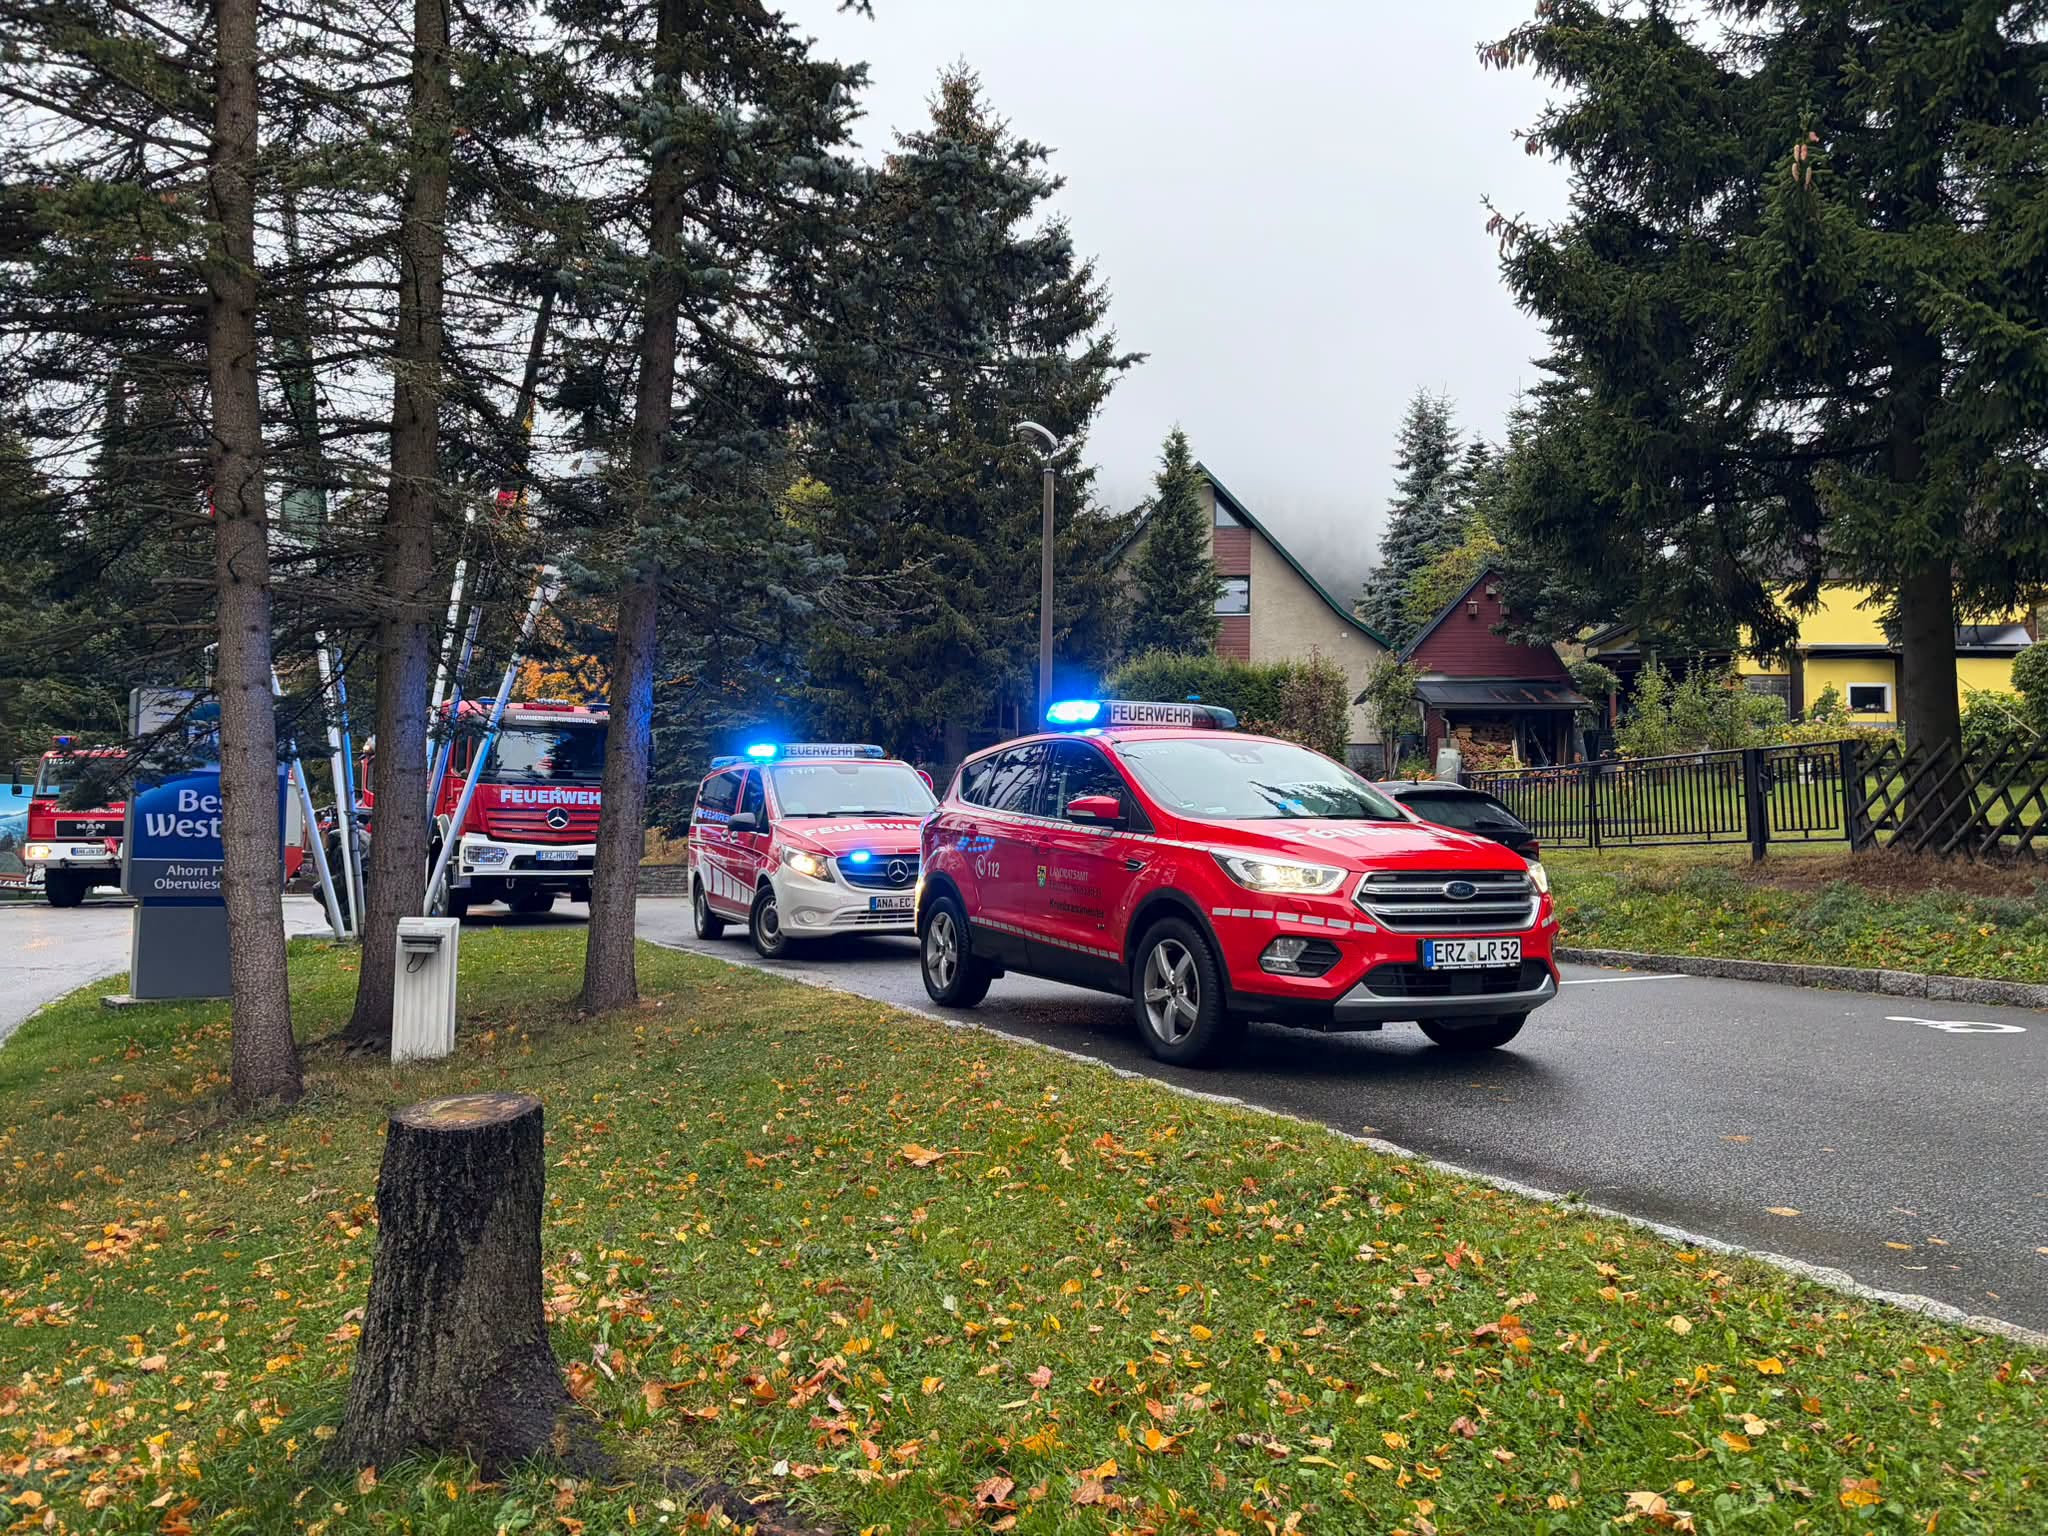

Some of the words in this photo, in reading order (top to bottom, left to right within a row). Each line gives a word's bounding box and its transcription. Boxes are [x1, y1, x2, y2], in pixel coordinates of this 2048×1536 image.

[1112, 705, 1191, 723] FEUERWEHR
[783, 745, 853, 756] FEUERWEHR
[178, 789, 222, 813] Be
[501, 789, 601, 805] FEUERWEH
[145, 813, 222, 838] West
[803, 823, 920, 837] FEUERWE
[166, 864, 208, 876] Ahorn
[987, 861, 1000, 878] 112
[1049, 865, 1089, 881] LANDRATSAMT
[154, 878, 221, 889] Oberwies
[876, 898, 894, 908] ANA
[899, 897, 911, 908] EC
[1434, 942, 1467, 964] ERZ
[1477, 941, 1497, 962] LR
[1500, 940, 1520, 961] 52
